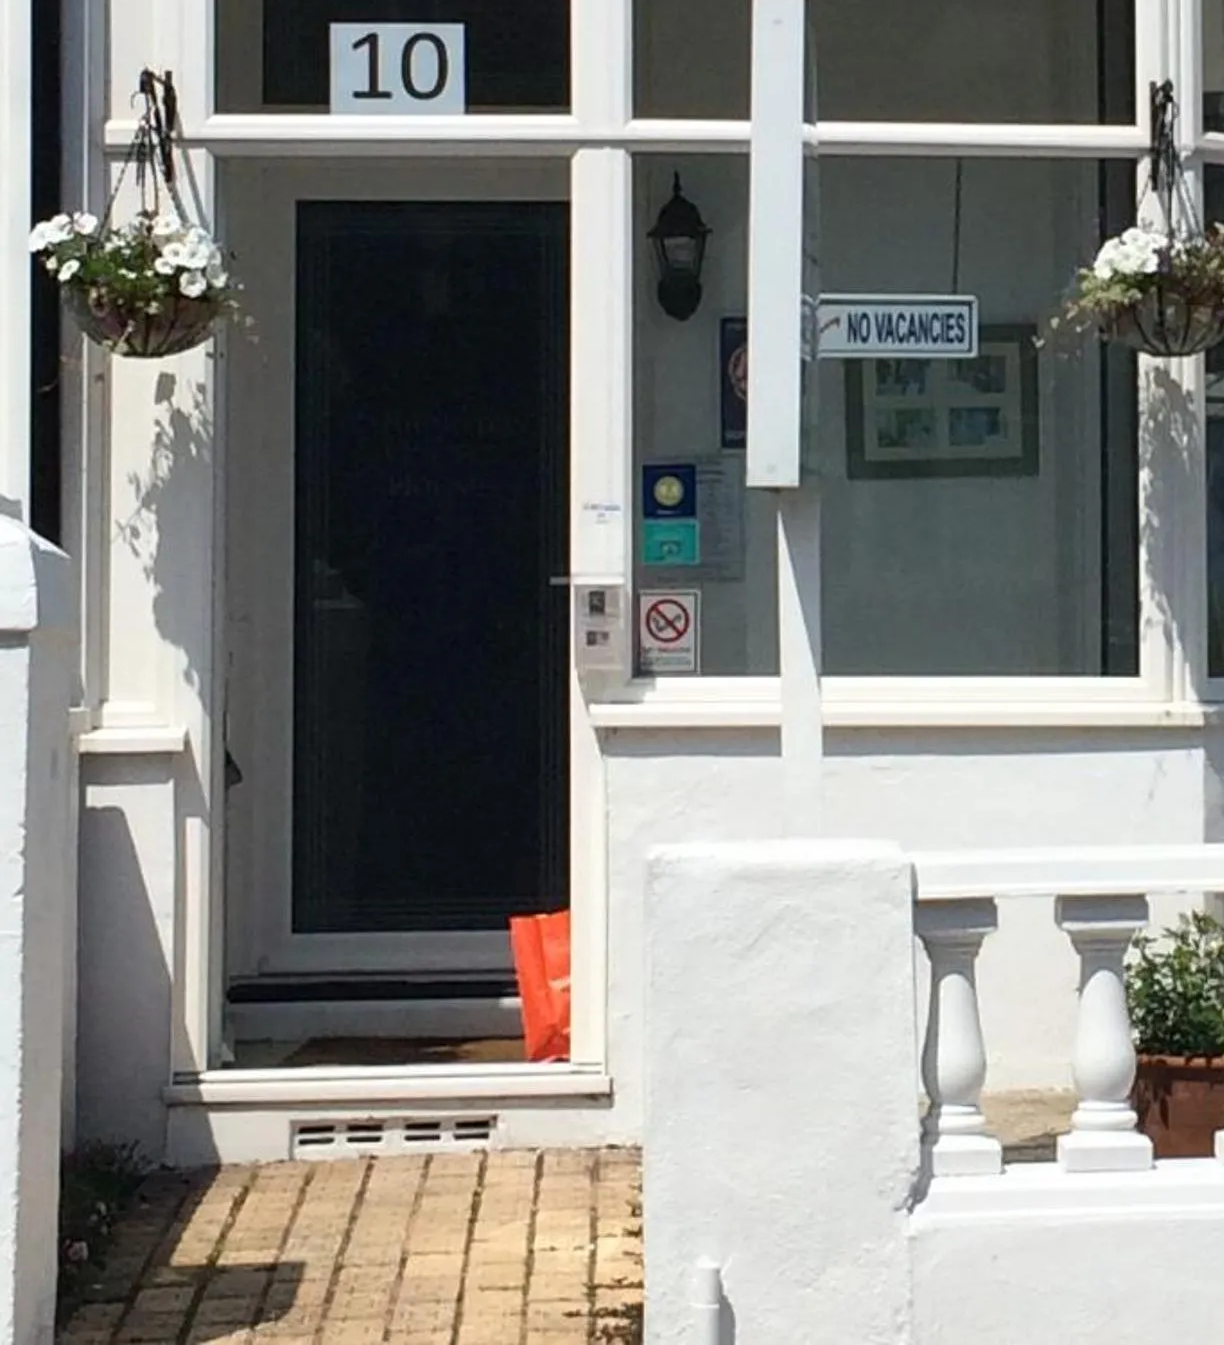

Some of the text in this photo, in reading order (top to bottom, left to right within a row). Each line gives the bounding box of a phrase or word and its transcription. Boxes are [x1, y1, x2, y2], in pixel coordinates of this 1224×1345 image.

[352, 31, 449, 101] 10
[847, 312, 966, 344] NO VACANCIES
